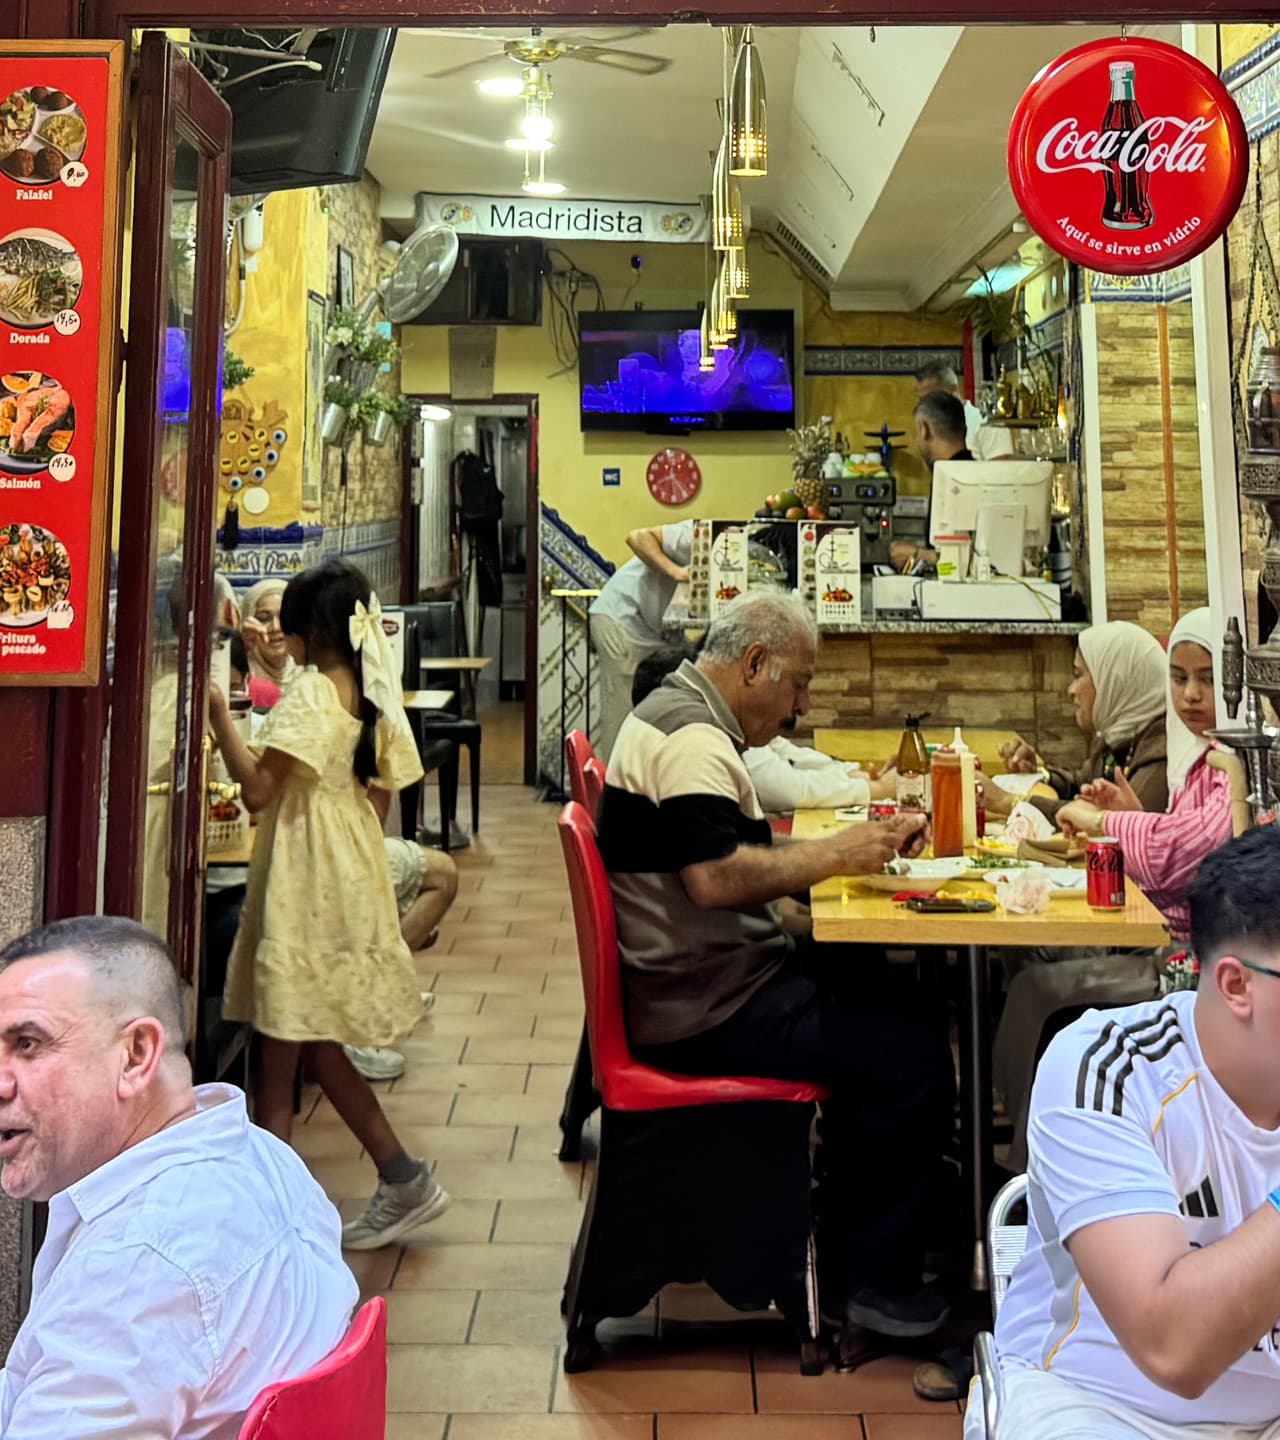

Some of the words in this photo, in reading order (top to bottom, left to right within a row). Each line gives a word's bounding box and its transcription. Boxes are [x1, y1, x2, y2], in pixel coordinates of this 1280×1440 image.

[1036, 115, 1217, 174] Coca-Cola
[16, 188, 53, 200] Falafel
[489, 204, 643, 234] Madridista
[1056, 215, 1088, 245] Aquí
[1088, 238, 1104, 251] se
[1105, 244, 1141, 257] sirve
[1144, 241, 1162, 254] en
[1163, 215, 1202, 248] vidrio
[9, 333, 50, 344] Dorada
[1, 643, 46, 657] pescado
